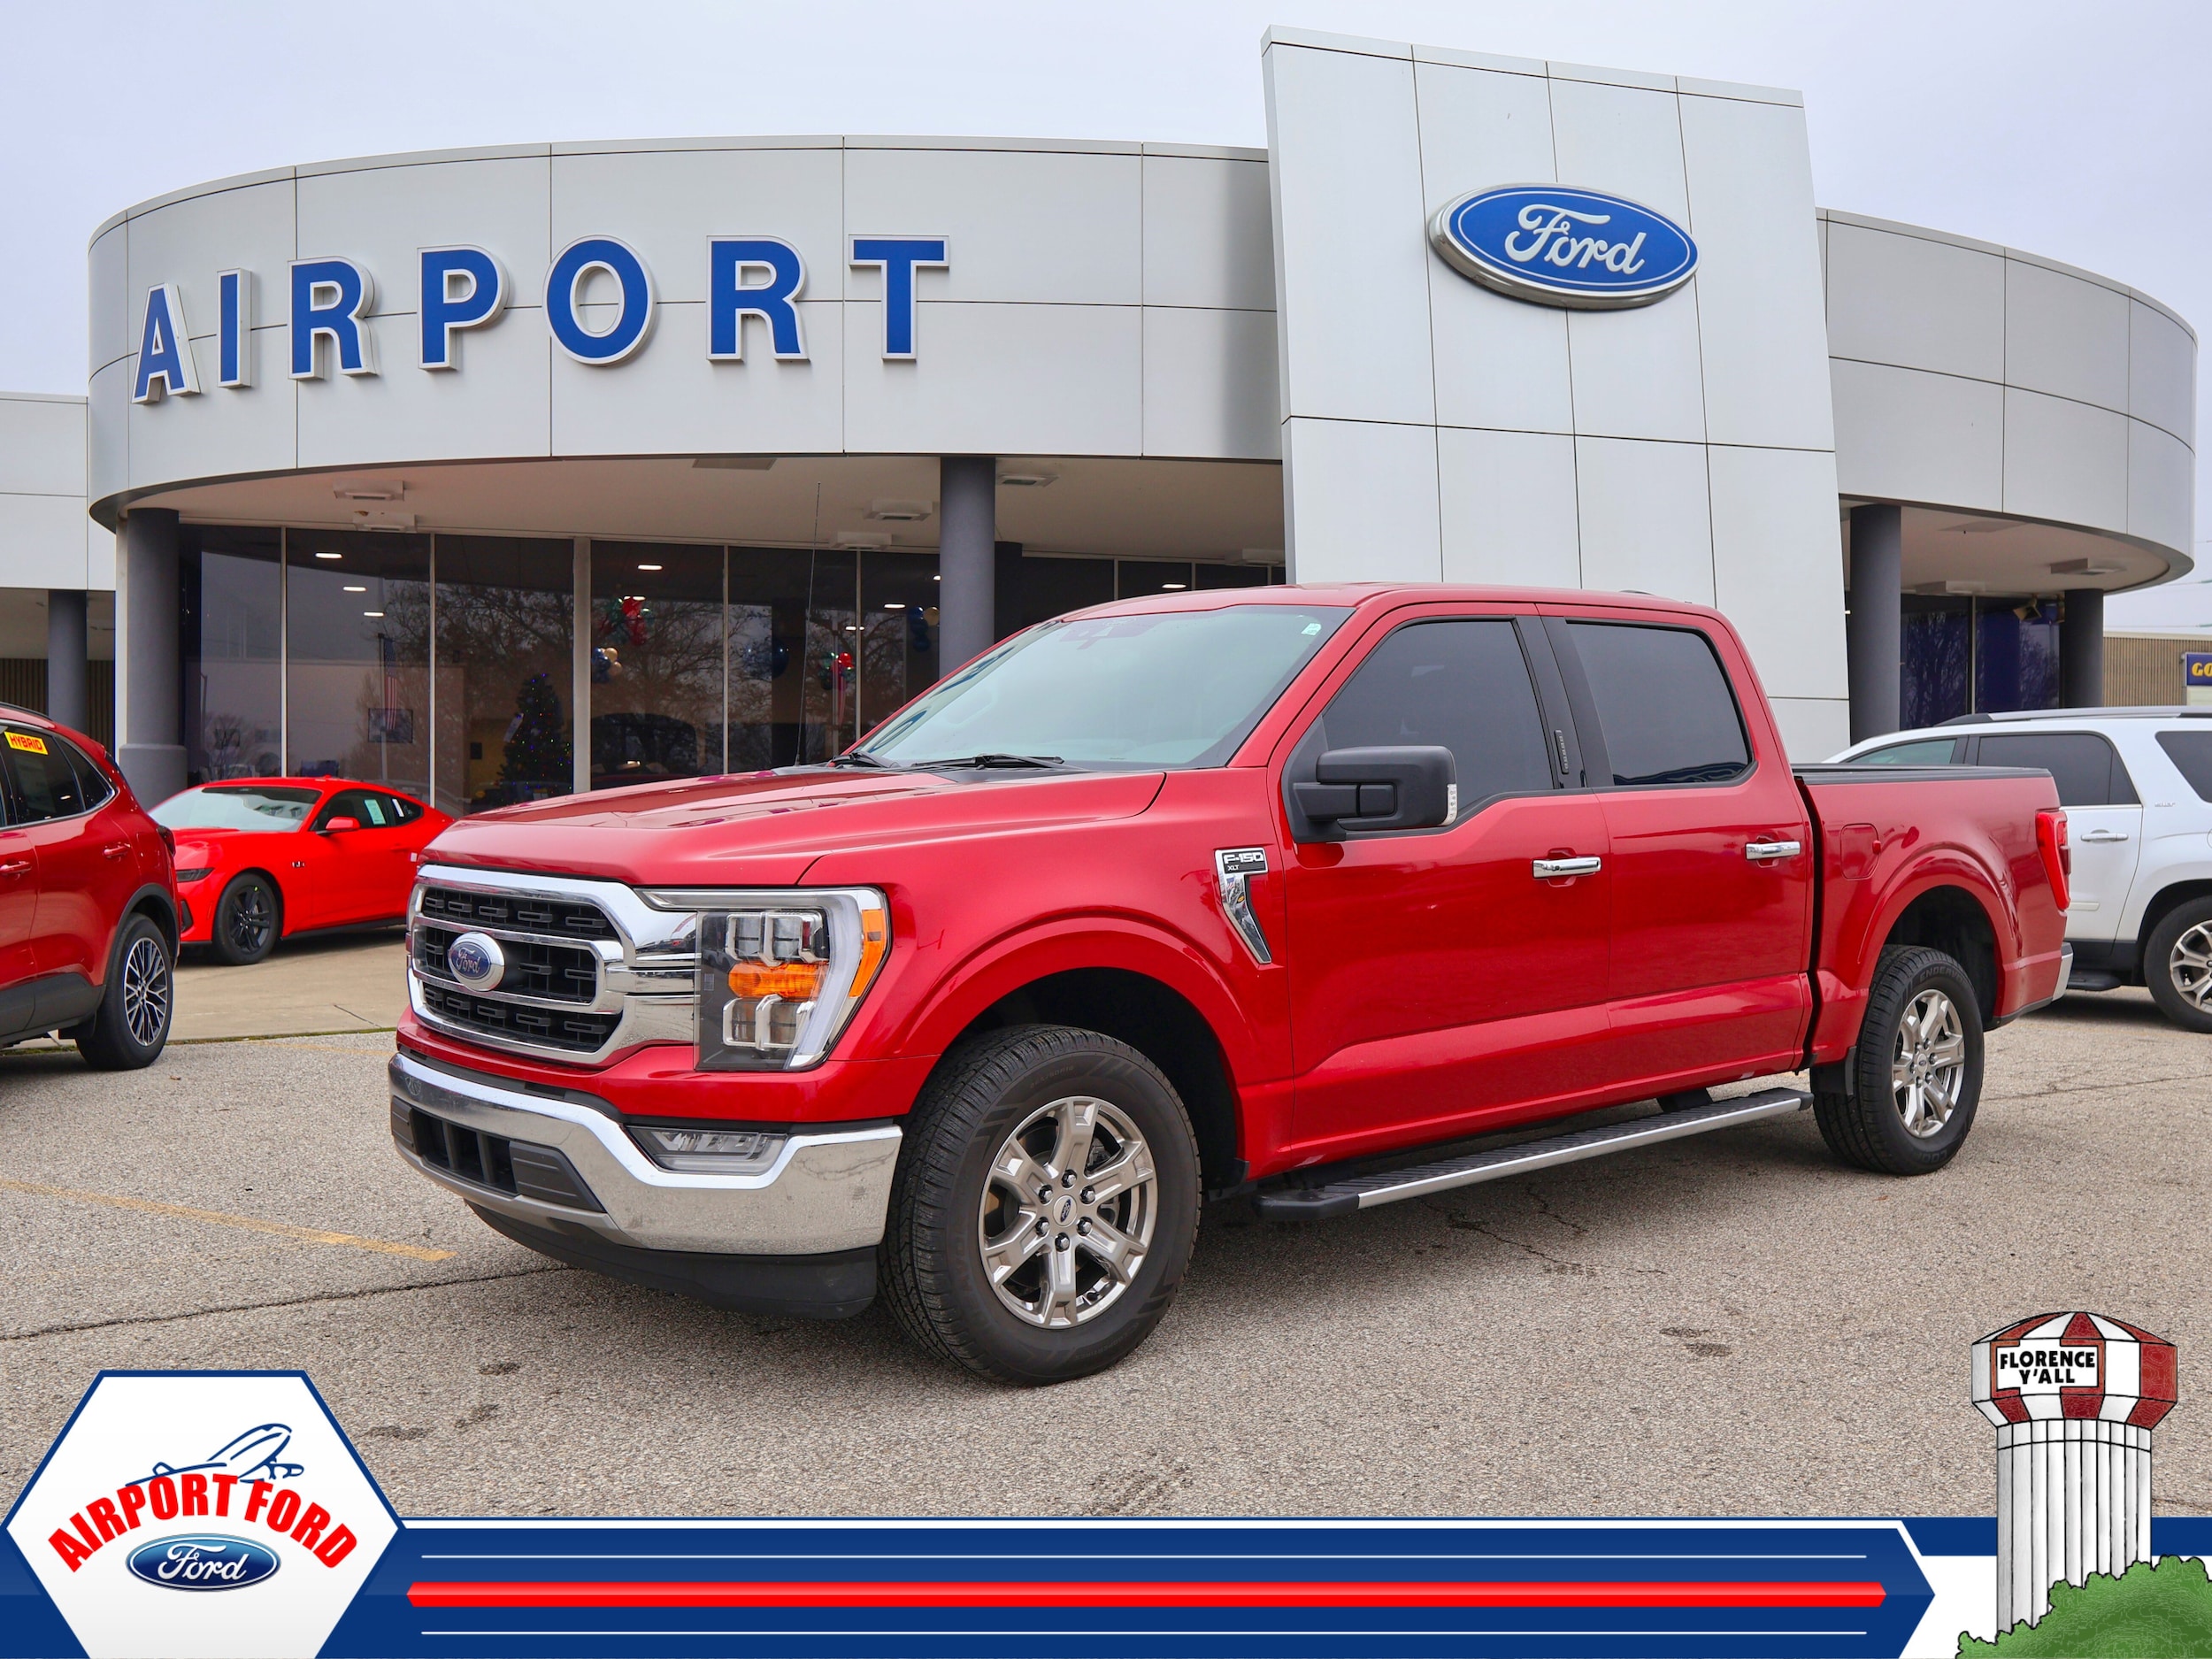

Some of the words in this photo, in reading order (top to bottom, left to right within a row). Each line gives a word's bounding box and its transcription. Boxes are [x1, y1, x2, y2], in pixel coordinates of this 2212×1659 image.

[1505, 204, 1647, 274] Ford
[131, 234, 949, 407] AIRPORT
[10, 734, 43, 750] HYBRID
[1224, 852, 1264, 864] F-150
[456, 947, 481, 973] Ford
